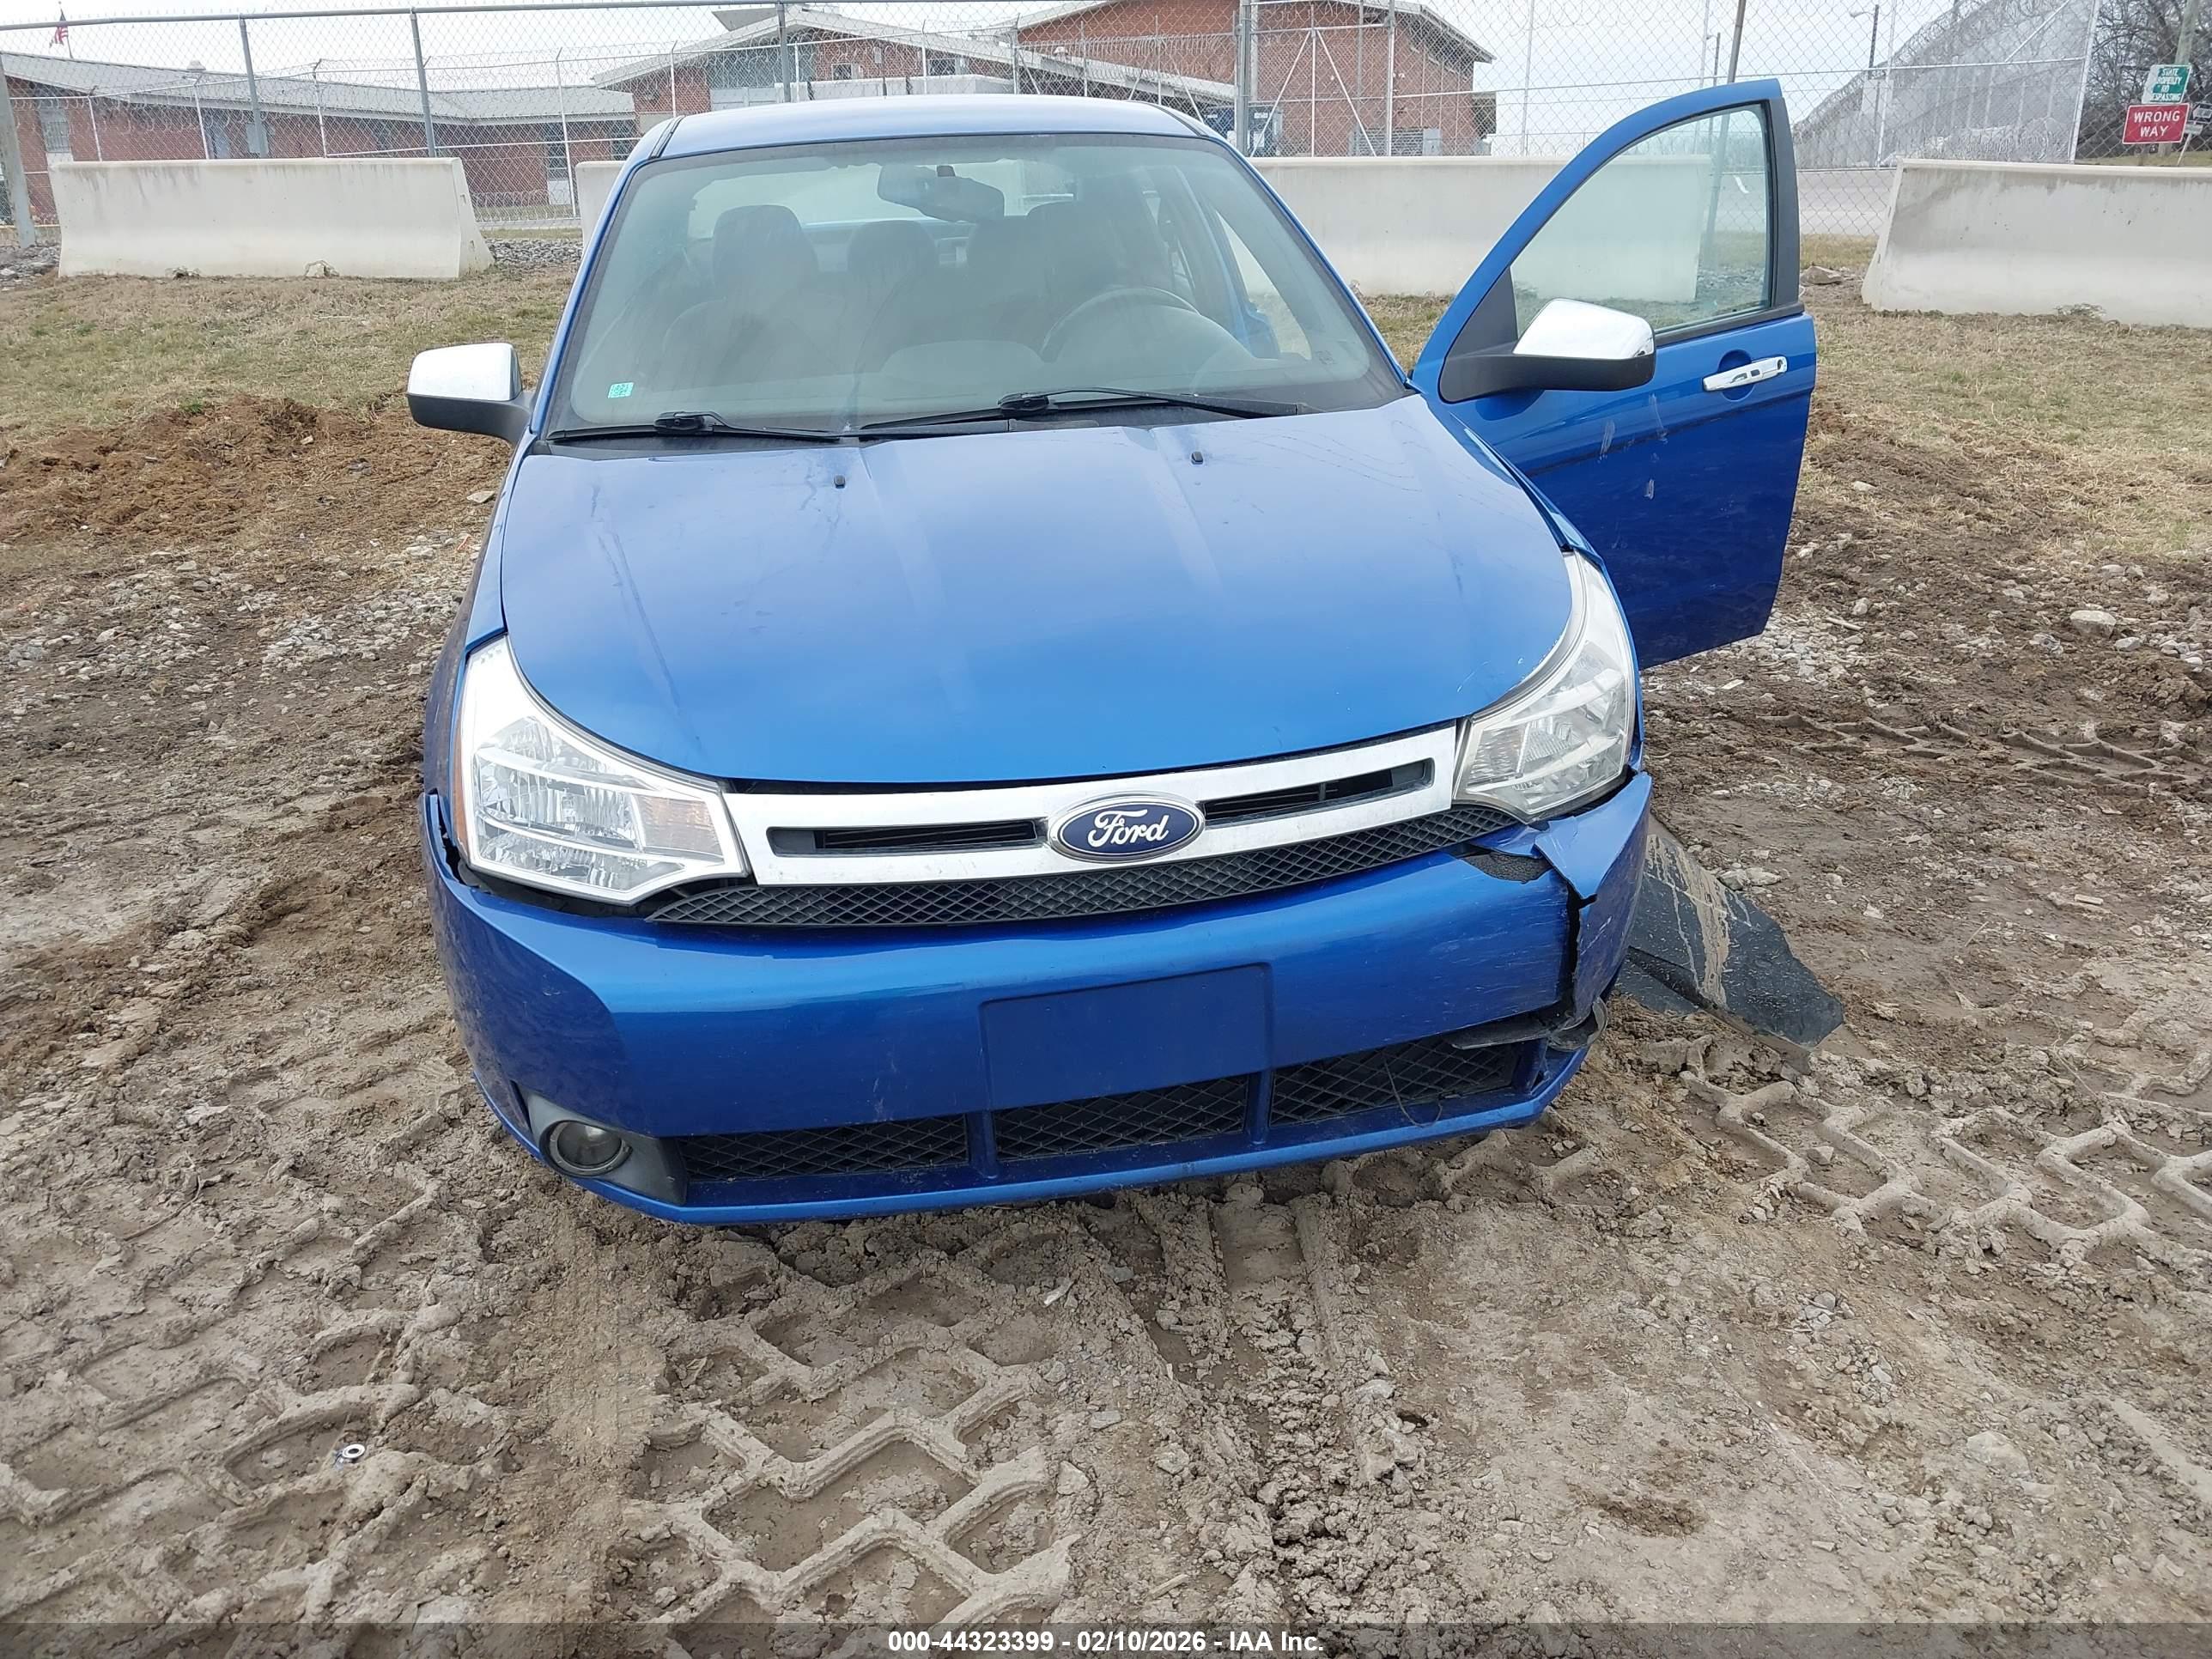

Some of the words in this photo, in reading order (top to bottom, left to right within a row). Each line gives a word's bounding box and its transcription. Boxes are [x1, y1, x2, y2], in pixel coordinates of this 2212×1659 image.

[2161, 68, 2179, 76] STATE
[2156, 76, 2183, 85] ROPERTY
[2134, 111, 2181, 123] WRONG
[2140, 125, 2169, 137] WAY
[1087, 809, 1170, 848] Ford
